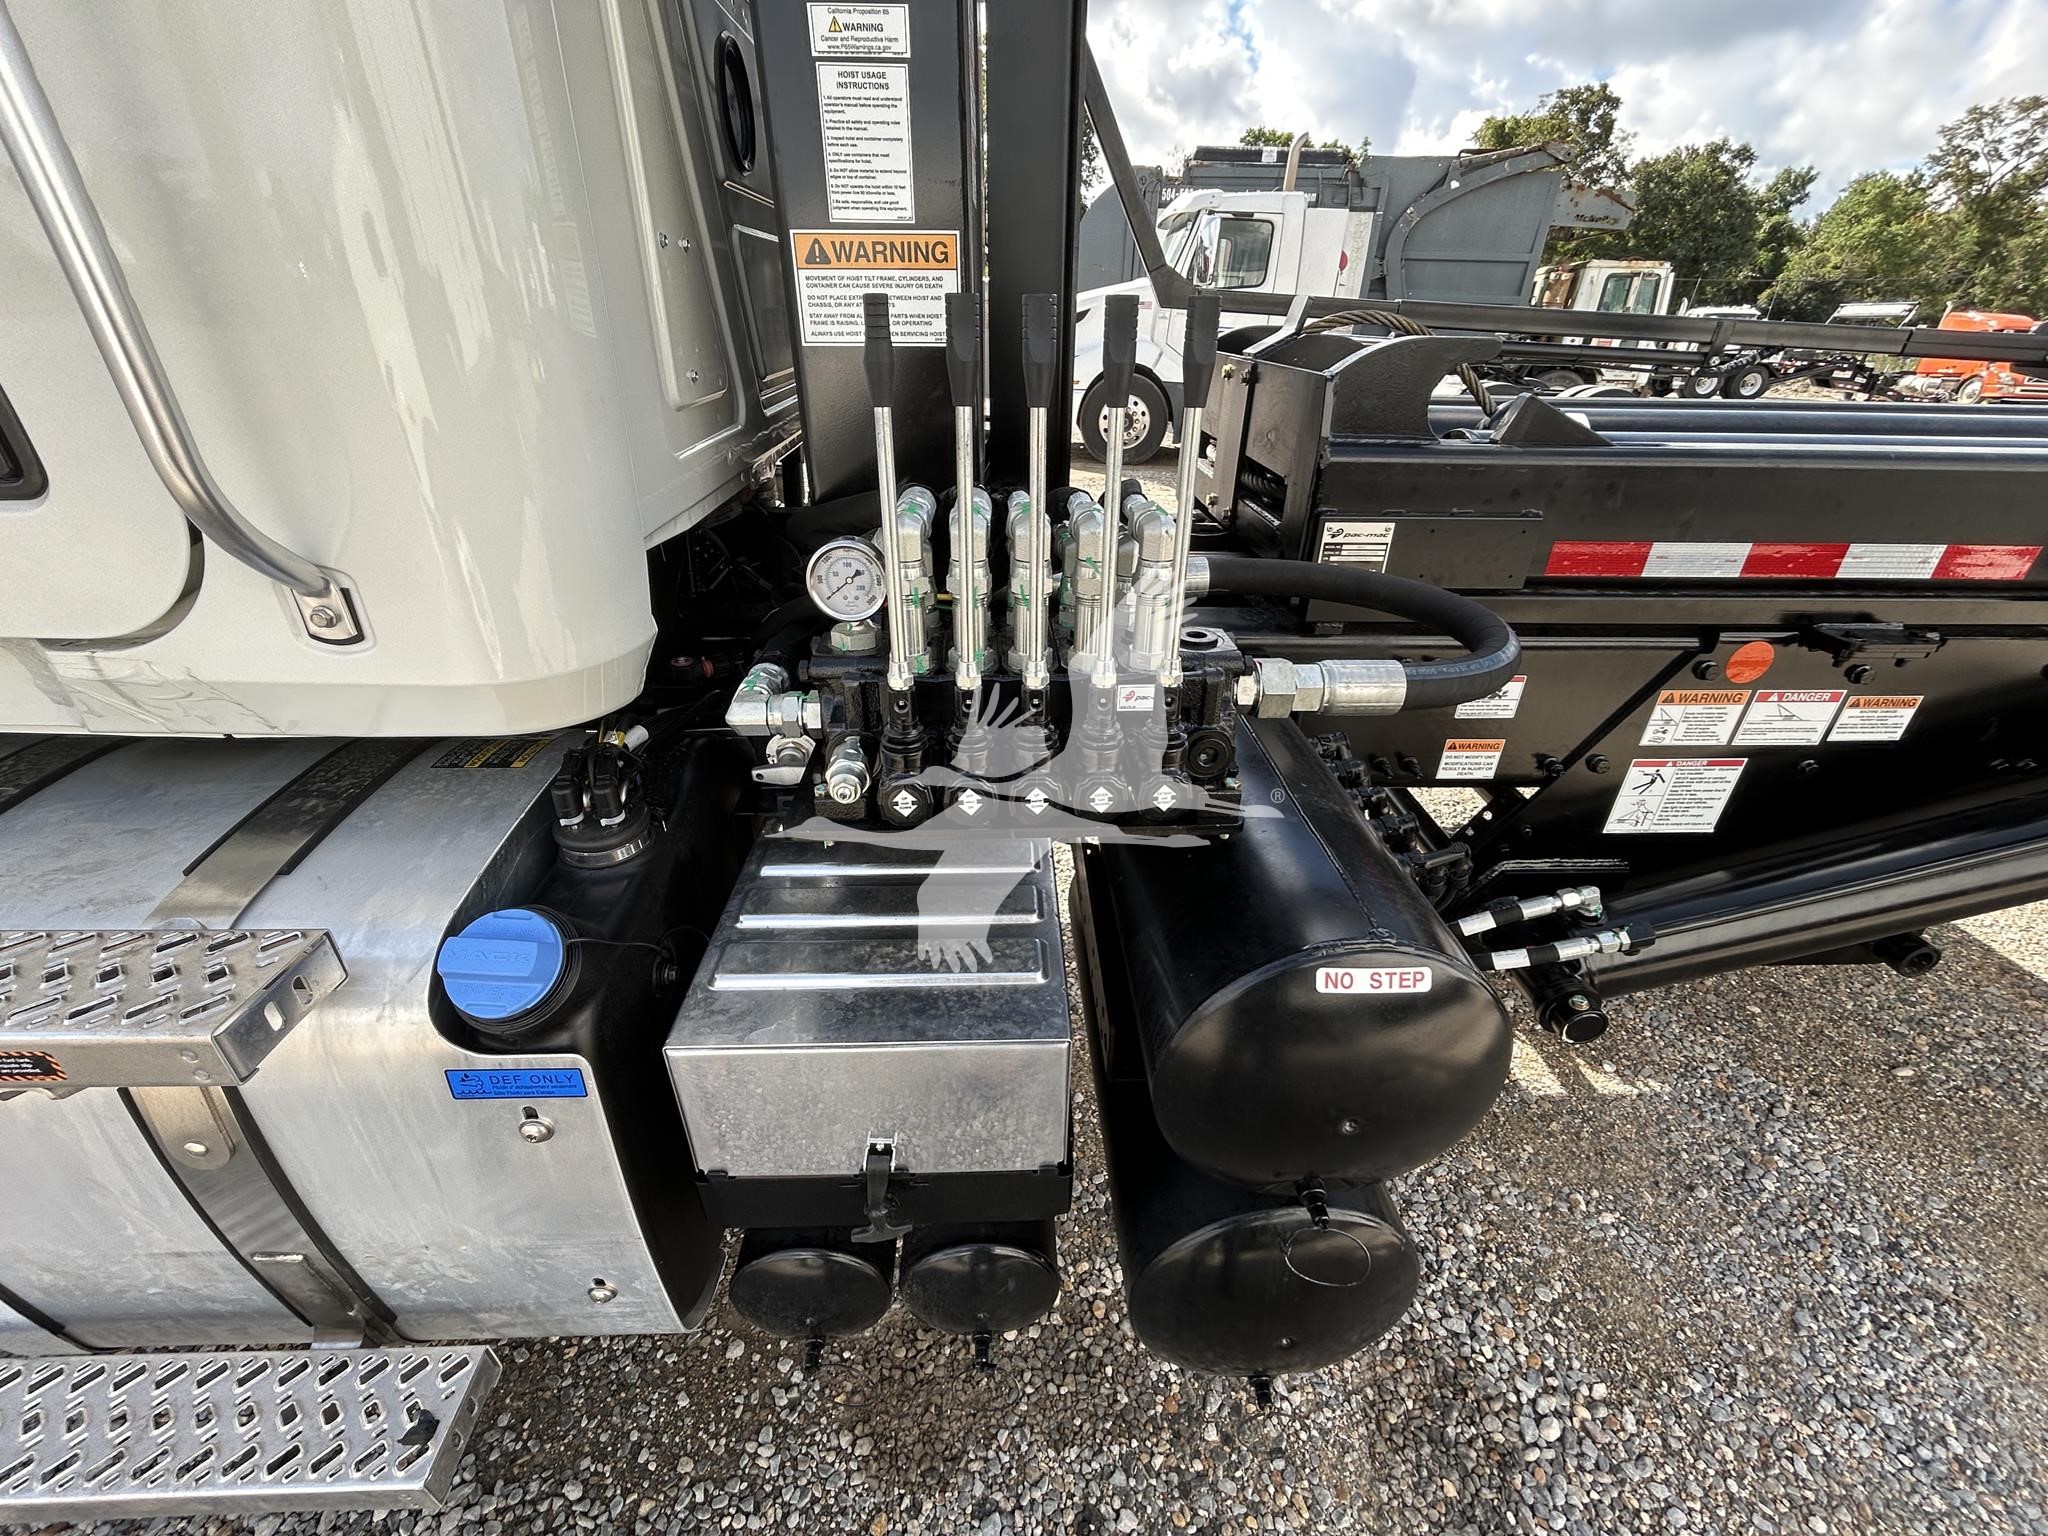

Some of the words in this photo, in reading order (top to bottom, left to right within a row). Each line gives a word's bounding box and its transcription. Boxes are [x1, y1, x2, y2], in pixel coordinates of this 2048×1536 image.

[842, 23, 883, 32] WARNING
[836, 82, 889, 90] INSTRUCTIONS
[831, 241, 949, 263] WARNING
[1679, 693, 1743, 703] WARNING
[1782, 693, 1831, 701] DANGER
[1863, 699, 1917, 707] WARNING
[1324, 972, 1354, 989] NO
[1370, 971, 1425, 989] STEP
[489, 1075, 522, 1085] DEF
[529, 1074, 575, 1084] ONLY
